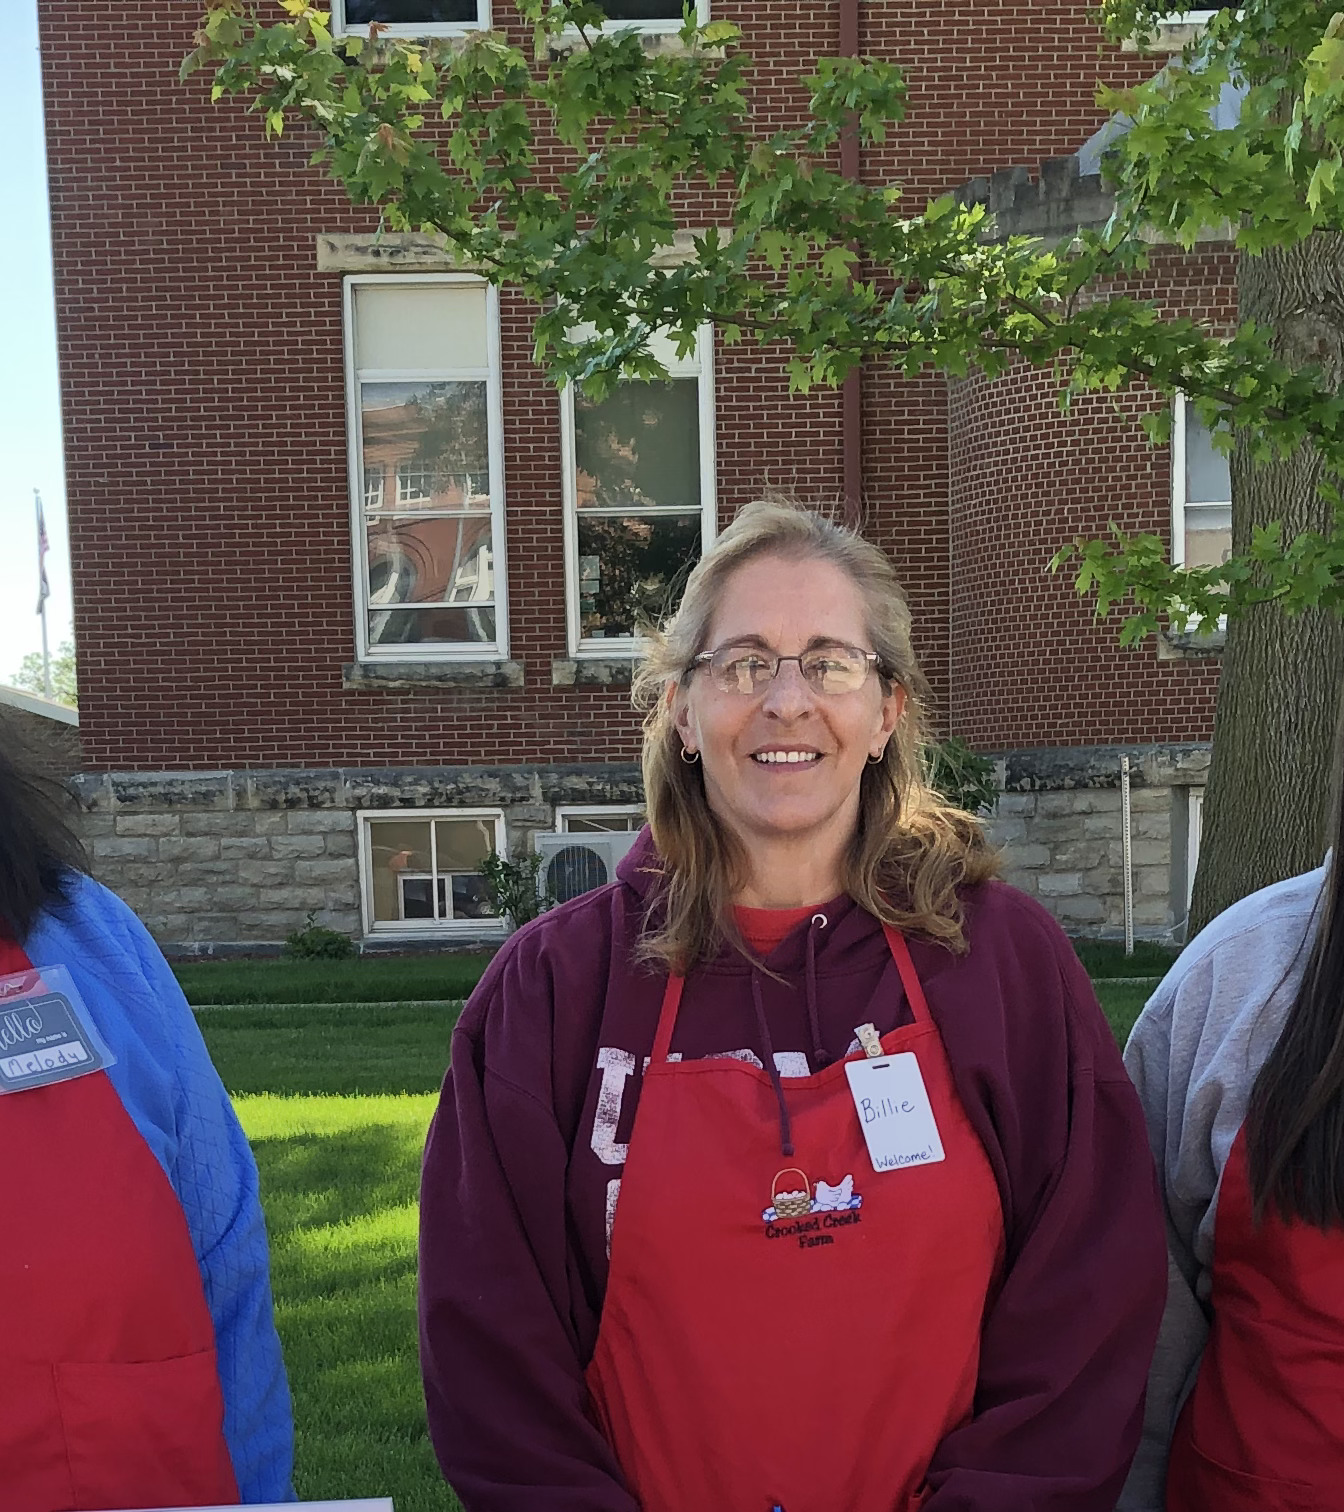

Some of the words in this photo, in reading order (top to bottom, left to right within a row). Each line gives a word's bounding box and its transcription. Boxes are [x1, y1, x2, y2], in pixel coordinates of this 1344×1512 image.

[8, 1049, 80, 1075] Melody
[860, 1097, 916, 1123] Billie
[875, 1144, 936, 1169] Welcome!
[765, 1218, 820, 1239] Crooked
[823, 1212, 862, 1230] Creek
[798, 1234, 834, 1249] Farm
